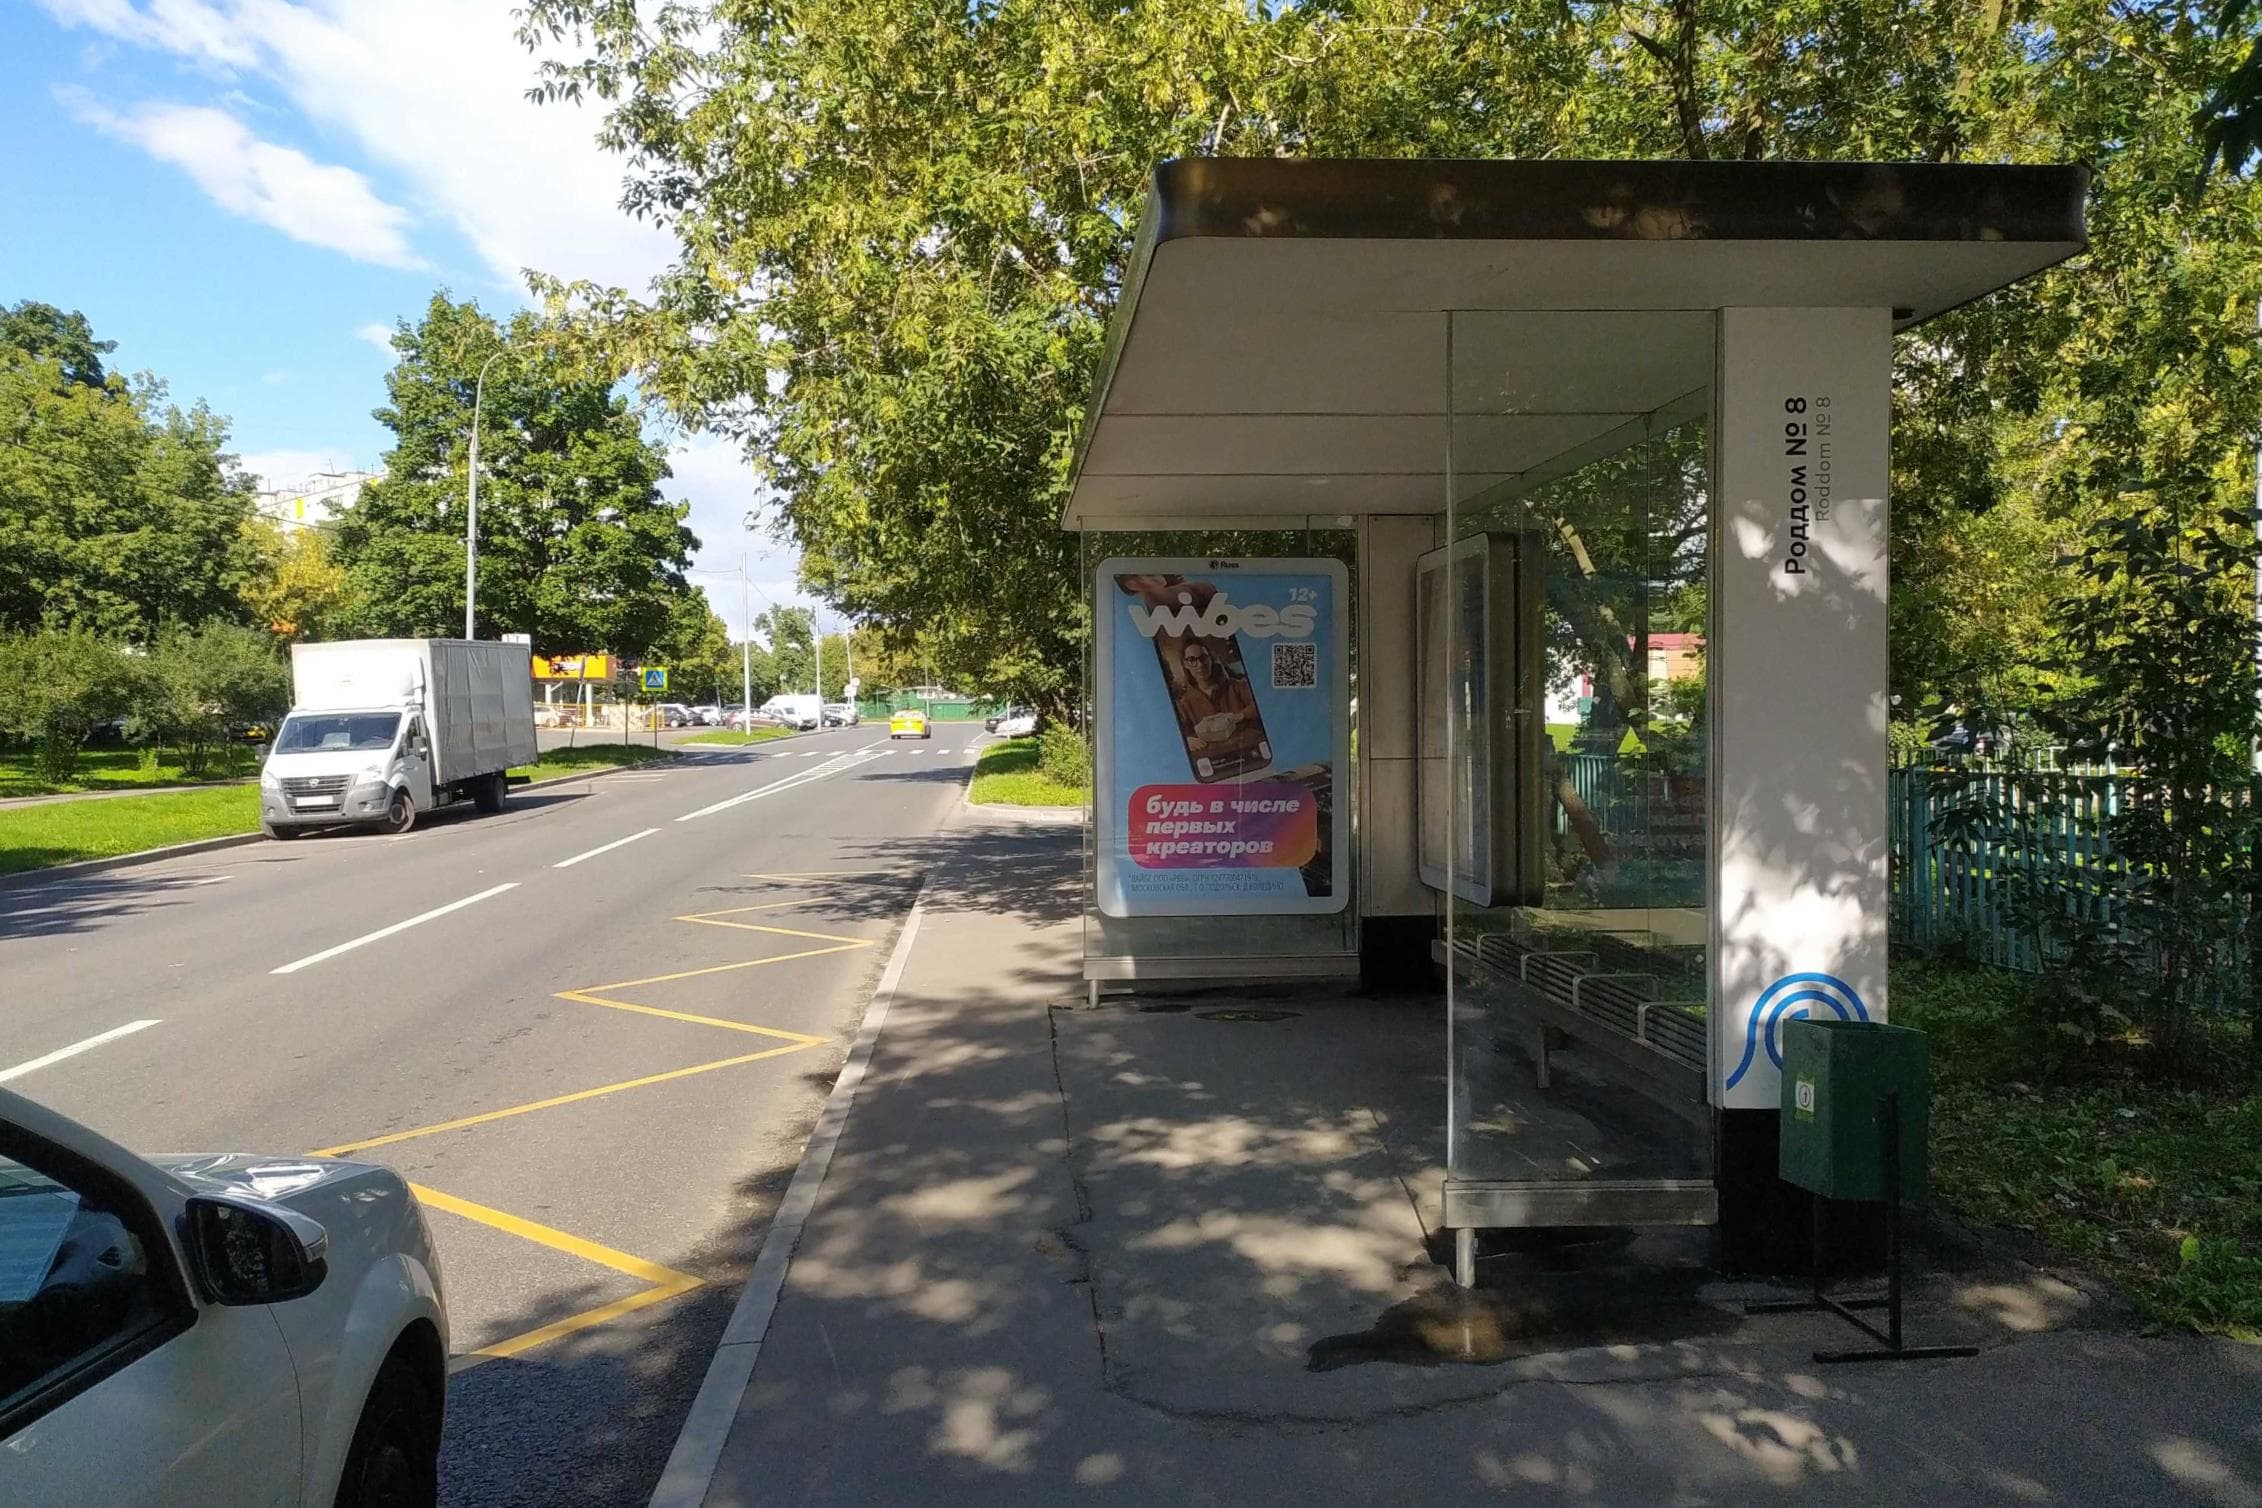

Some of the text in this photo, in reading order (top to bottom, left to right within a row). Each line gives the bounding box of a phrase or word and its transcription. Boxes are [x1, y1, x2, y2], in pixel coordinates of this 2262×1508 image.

[1814, 396, 1831, 521] Roddom № 8
[1784, 397, 1809, 574] Роддом № 8
[1289, 586, 1318, 602] 12+
[1146, 794, 1301, 817] будь в числе
[1146, 821, 1236, 839] первых
[1146, 840, 1275, 859] креаторов
